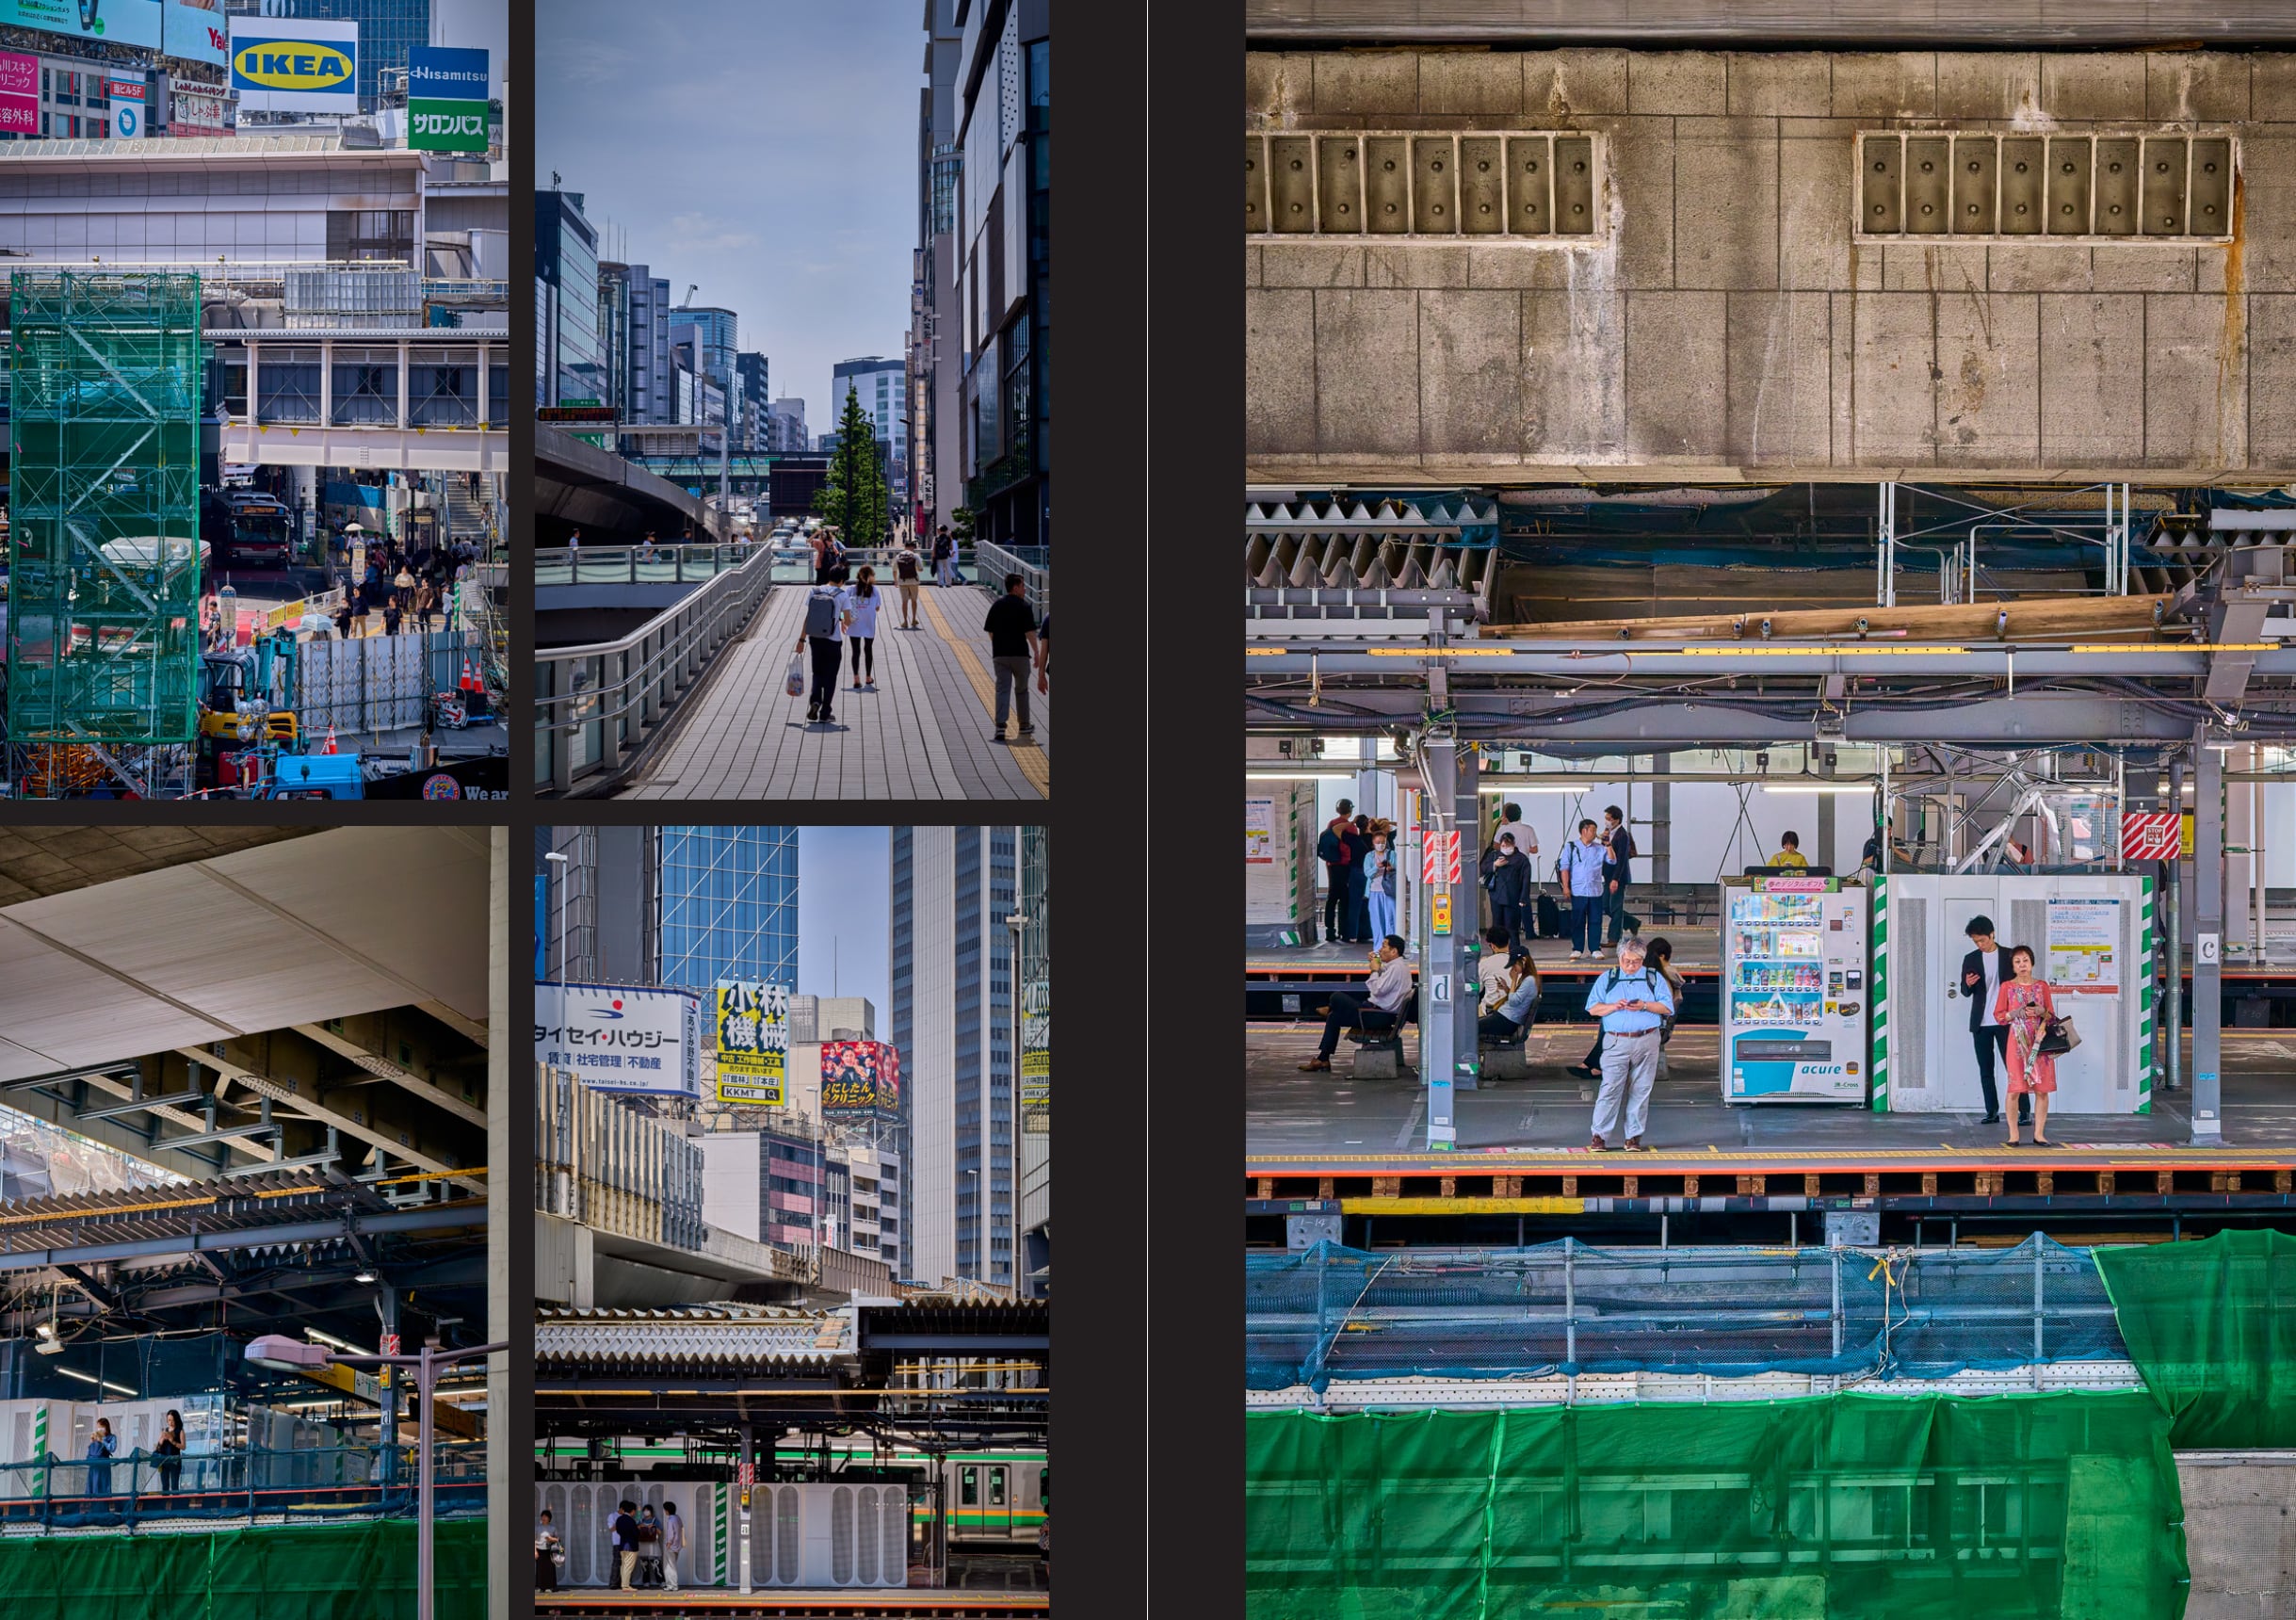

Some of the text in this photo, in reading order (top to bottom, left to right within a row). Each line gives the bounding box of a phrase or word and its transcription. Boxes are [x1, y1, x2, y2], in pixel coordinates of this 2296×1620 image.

[0, 58, 35, 74] 川スキン
[245, 53, 346, 77] IKEA
[0, 73, 31, 89] リニック
[410, 66, 488, 82] Hisamitsu
[113, 83, 142, 97] 当ビル5F
[0, 106, 35, 127] 容外科
[413, 114, 484, 136] サロンパス
[464, 786, 489, 800] We
[1434, 975, 1448, 1000] d
[727, 982, 787, 1016] 小林
[535, 1024, 679, 1048] タイセイ・ハウジー
[726, 1014, 788, 1049] 機械
[577, 1053, 622, 1067] 社宅管理
[627, 1056, 662, 1070] 不動産
[1802, 1065, 1842, 1075] acure
[726, 1087, 755, 1097] KKMT
[831, 1081, 871, 1094] にしたん
[830, 1093, 876, 1105] クリニック
[382, 1411, 391, 1424] d
